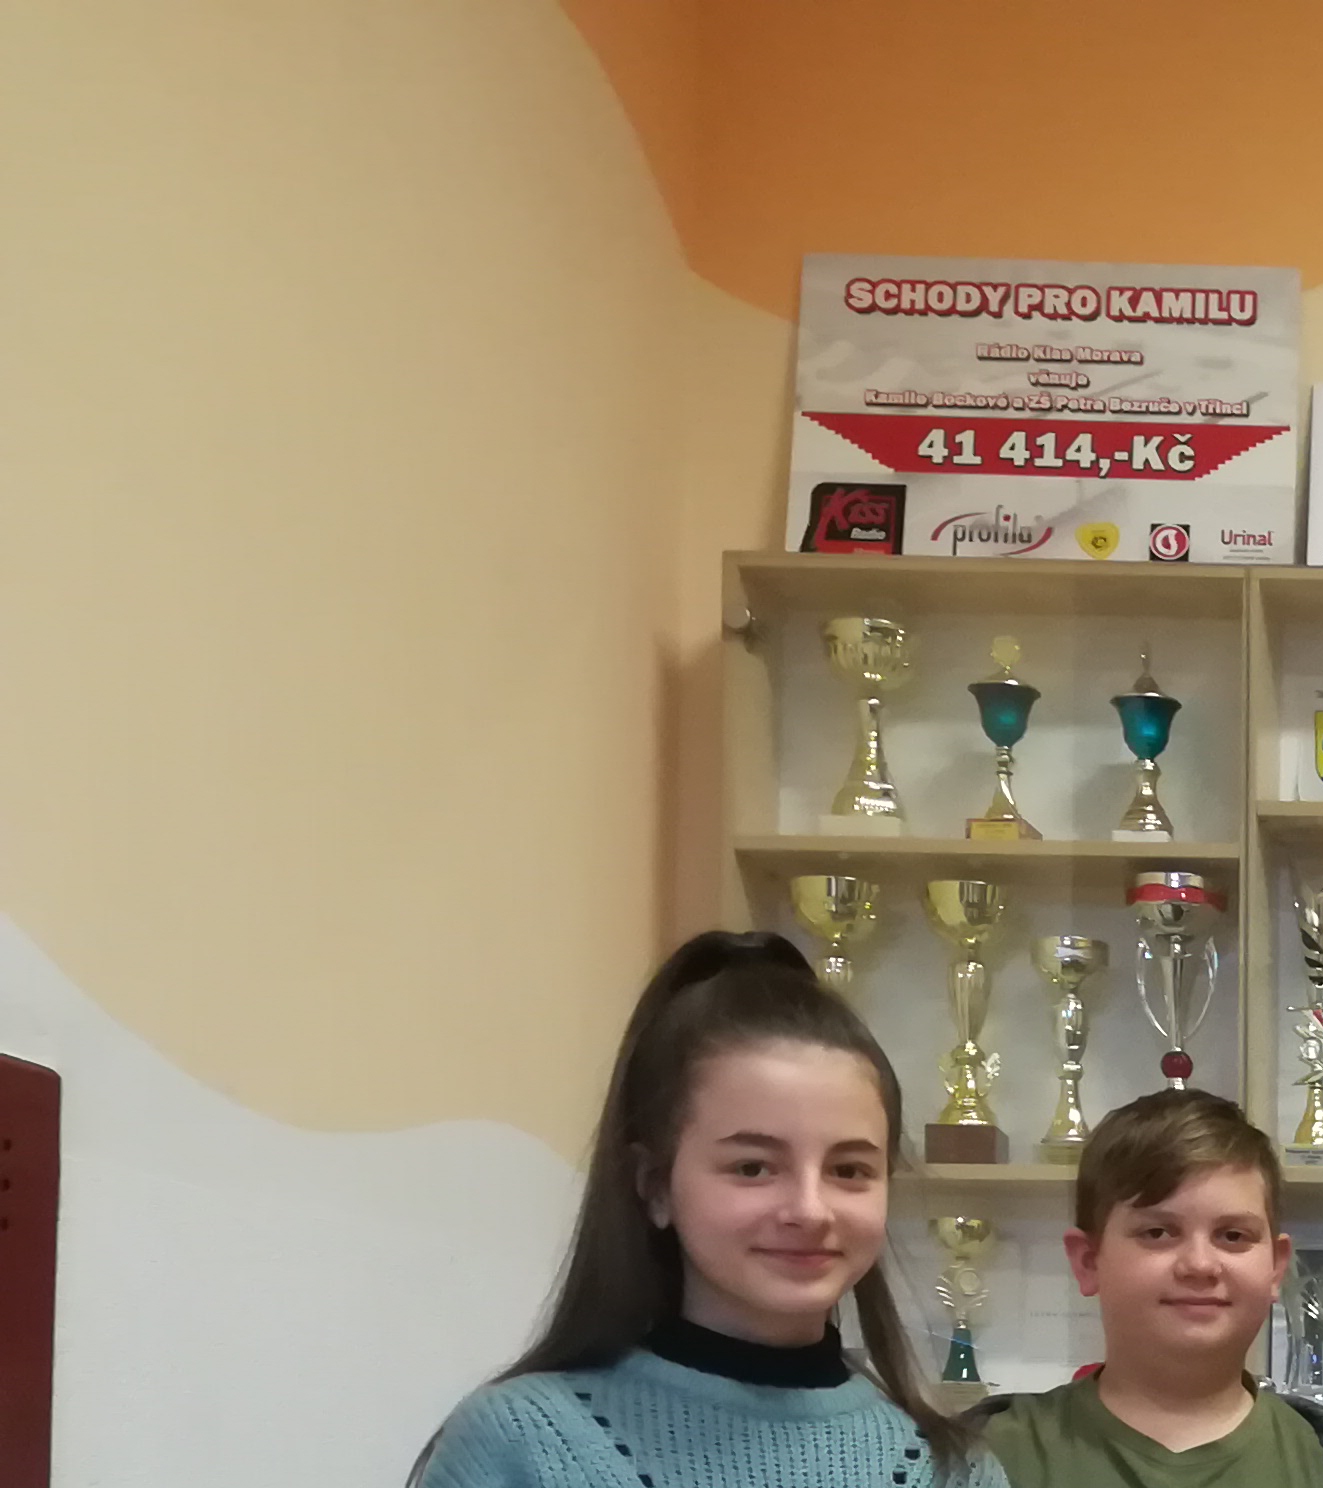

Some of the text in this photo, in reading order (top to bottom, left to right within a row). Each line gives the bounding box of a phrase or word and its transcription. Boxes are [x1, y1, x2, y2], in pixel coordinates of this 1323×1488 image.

[845, 278, 1258, 326] SCHODY PRO KAMILU
[1075, 346, 1144, 366] Morava
[1027, 369, 1090, 390] věnuje
[1012, 397, 1025, 410] a
[1027, 391, 1052, 411] ZŠ
[1055, 394, 1107, 413] Petra
[1183, 402, 1196, 415] v
[917, 428, 1196, 479] 41 414,-Kč
[1220, 529, 1273, 547] Urinal
